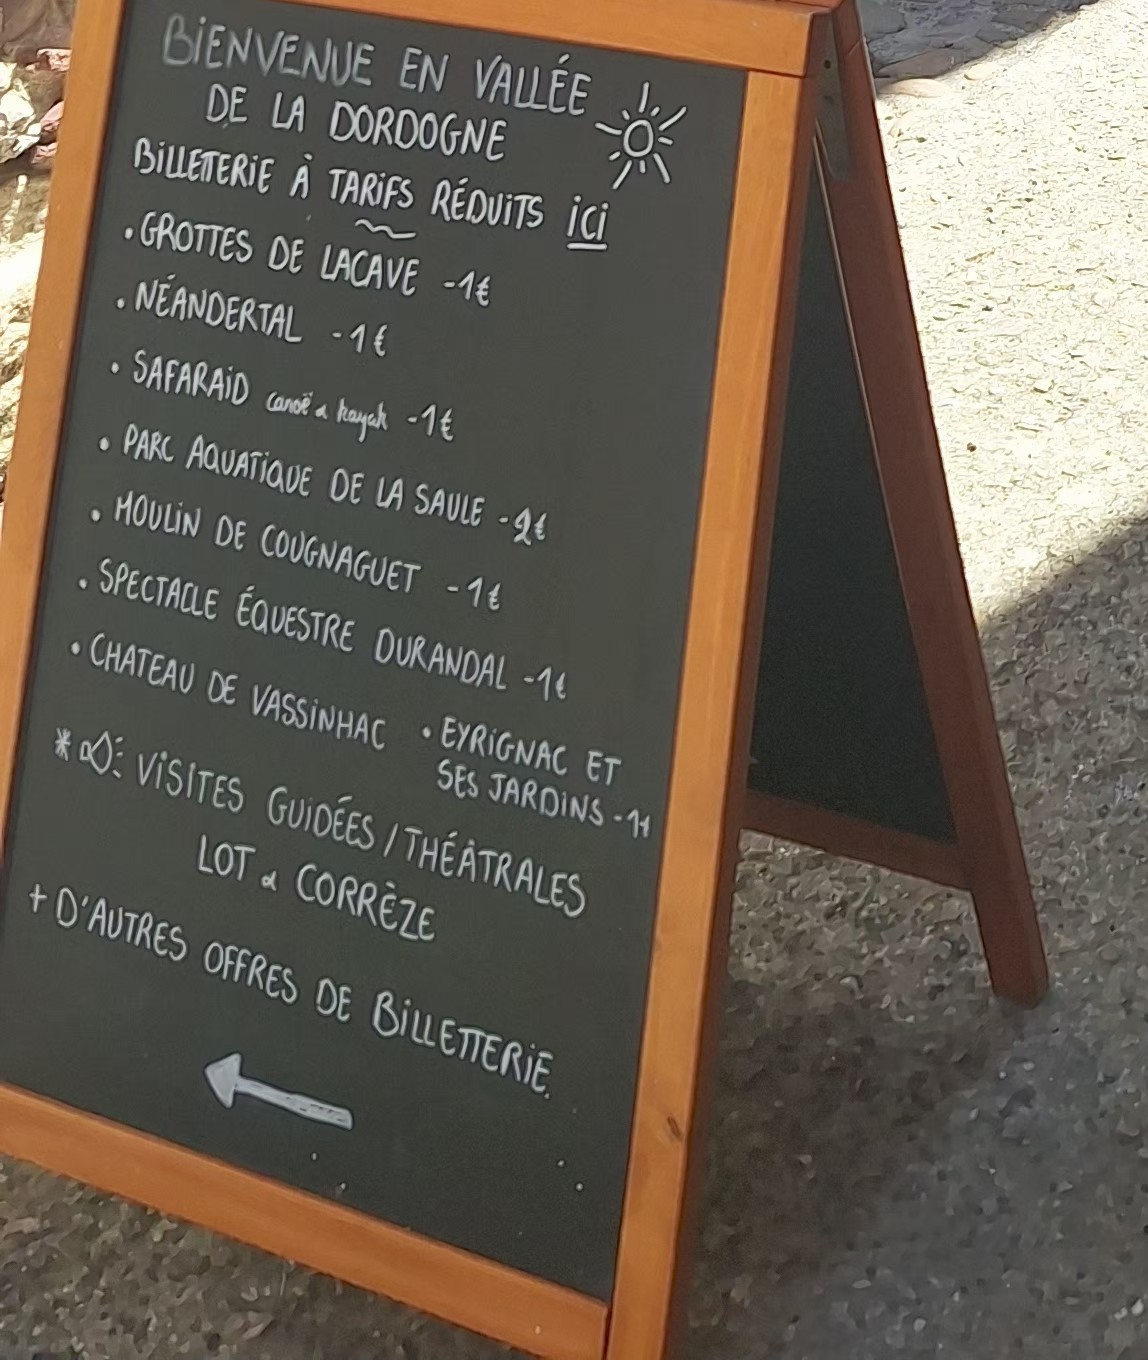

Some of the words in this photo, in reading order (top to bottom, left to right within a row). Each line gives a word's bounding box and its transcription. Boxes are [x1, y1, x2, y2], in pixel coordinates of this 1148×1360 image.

[400, 46, 450, 93] EN
[475, 54, 592, 116] VALLÉE
[205, 83, 248, 124] DE
[271, 91, 305, 132] LA
[329, 101, 507, 161] DORDOGNE
[139, 211, 253, 263] GROTTES
[267, 235, 304, 274] DE
[320, 244, 420, 296] LACAVE
[134, 273, 303, 343] NÉANDERTAL
[336, 397, 388, 443] kayak
[123, 423, 175, 463] PARC
[329, 467, 365, 505] DE
[375, 476, 404, 511] LA
[413, 483, 487, 528] SAULE
[214, 514, 248, 551] DE
[260, 523, 422, 594] COUGNAGUET
[98, 558, 220, 621] SPECTACLE
[236, 585, 357, 653] ÉQUESTRE
[374, 627, 508, 690] DURANDAL
[89, 633, 195, 695] CHATEAU
[207, 670, 239, 705] DE
[437, 758, 479, 799] SES
[586, 750, 622, 785] ET
[197, 834, 256, 881] LOT
[294, 863, 436, 941] CORRÈZE
[55, 887, 188, 962] D'AUTRES
[202, 941, 299, 1005] OFFRES
[315, 978, 353, 1023] DE
